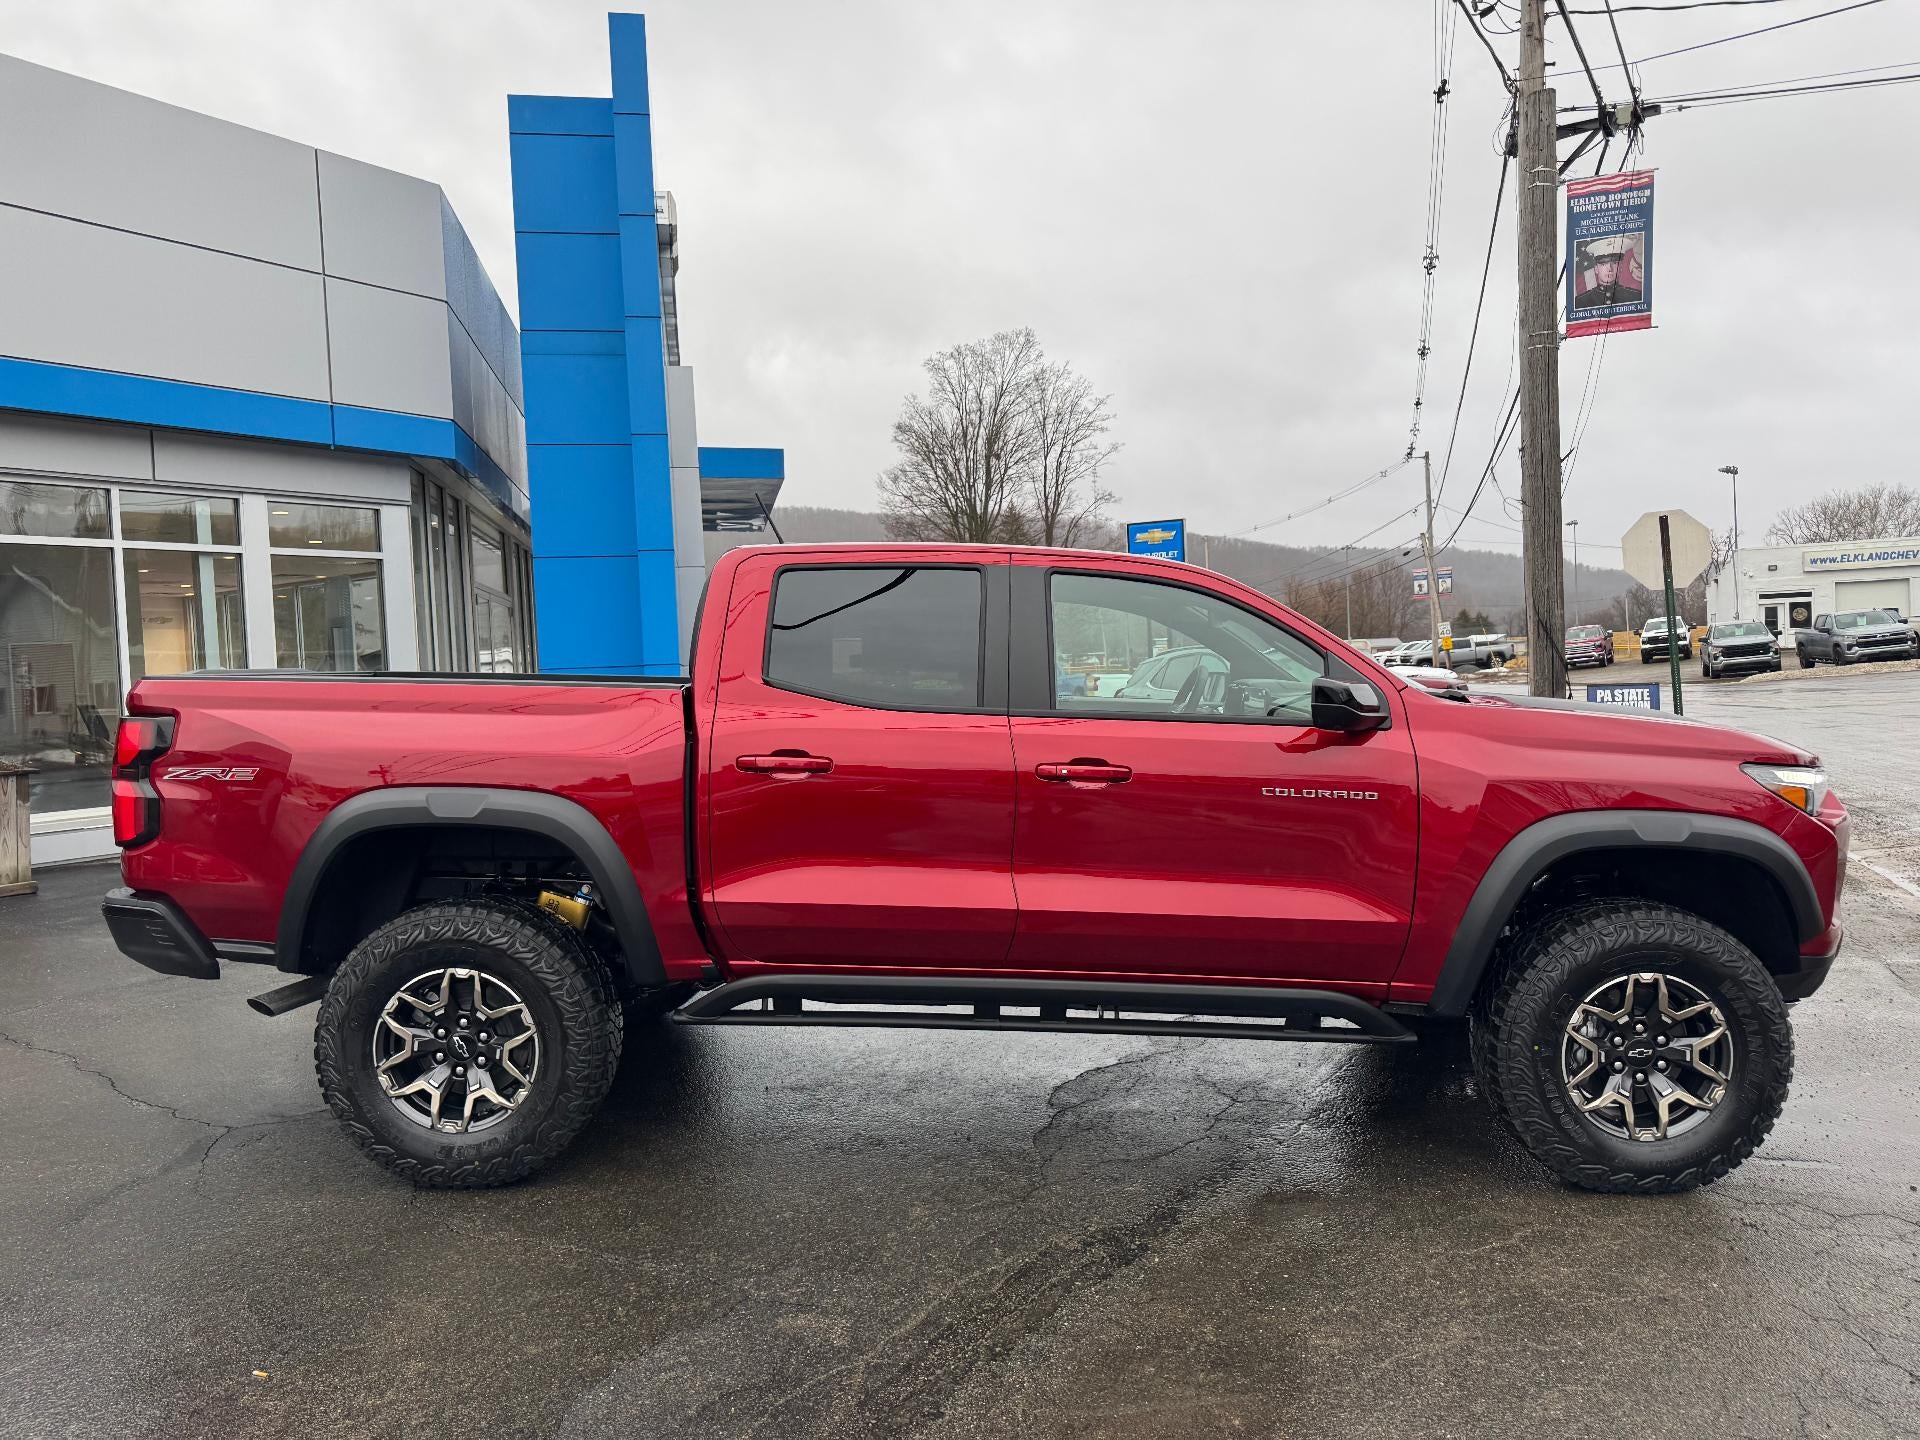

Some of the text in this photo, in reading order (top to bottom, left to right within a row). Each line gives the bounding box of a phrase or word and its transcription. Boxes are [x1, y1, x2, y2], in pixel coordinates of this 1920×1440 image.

[1573, 197, 1647, 213] HOMETOWN HERO
[1580, 216, 1613, 226] MICHAEL
[1589, 224, 1618, 233] MARINE
[1597, 688, 1650, 702] PA STATE
[162, 767, 260, 781] ZR2
[1261, 787, 1379, 800] COLORADO
